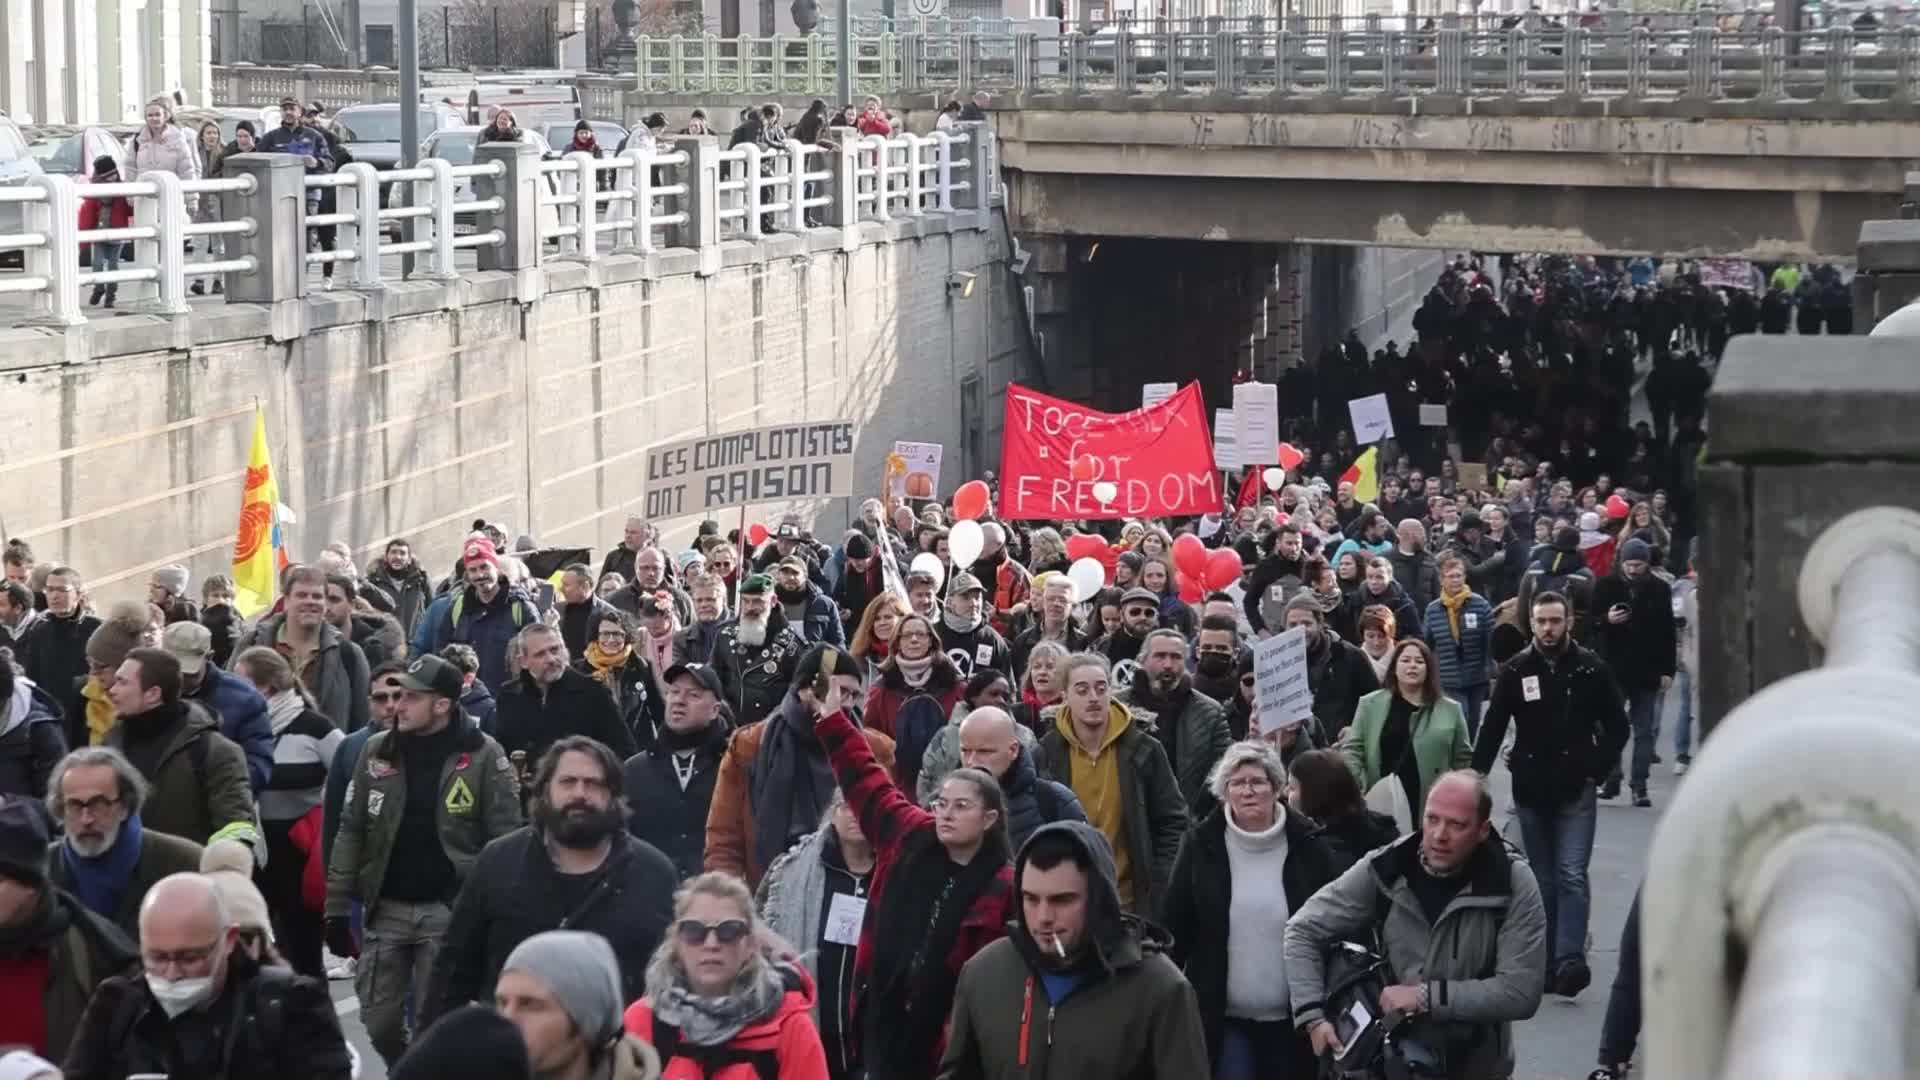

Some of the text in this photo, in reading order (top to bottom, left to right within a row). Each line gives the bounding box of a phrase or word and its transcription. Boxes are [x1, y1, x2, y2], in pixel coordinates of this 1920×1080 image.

[649, 423, 853, 481] LES COMPLOTISTES
[646, 463, 832, 519] ONT RAISON
